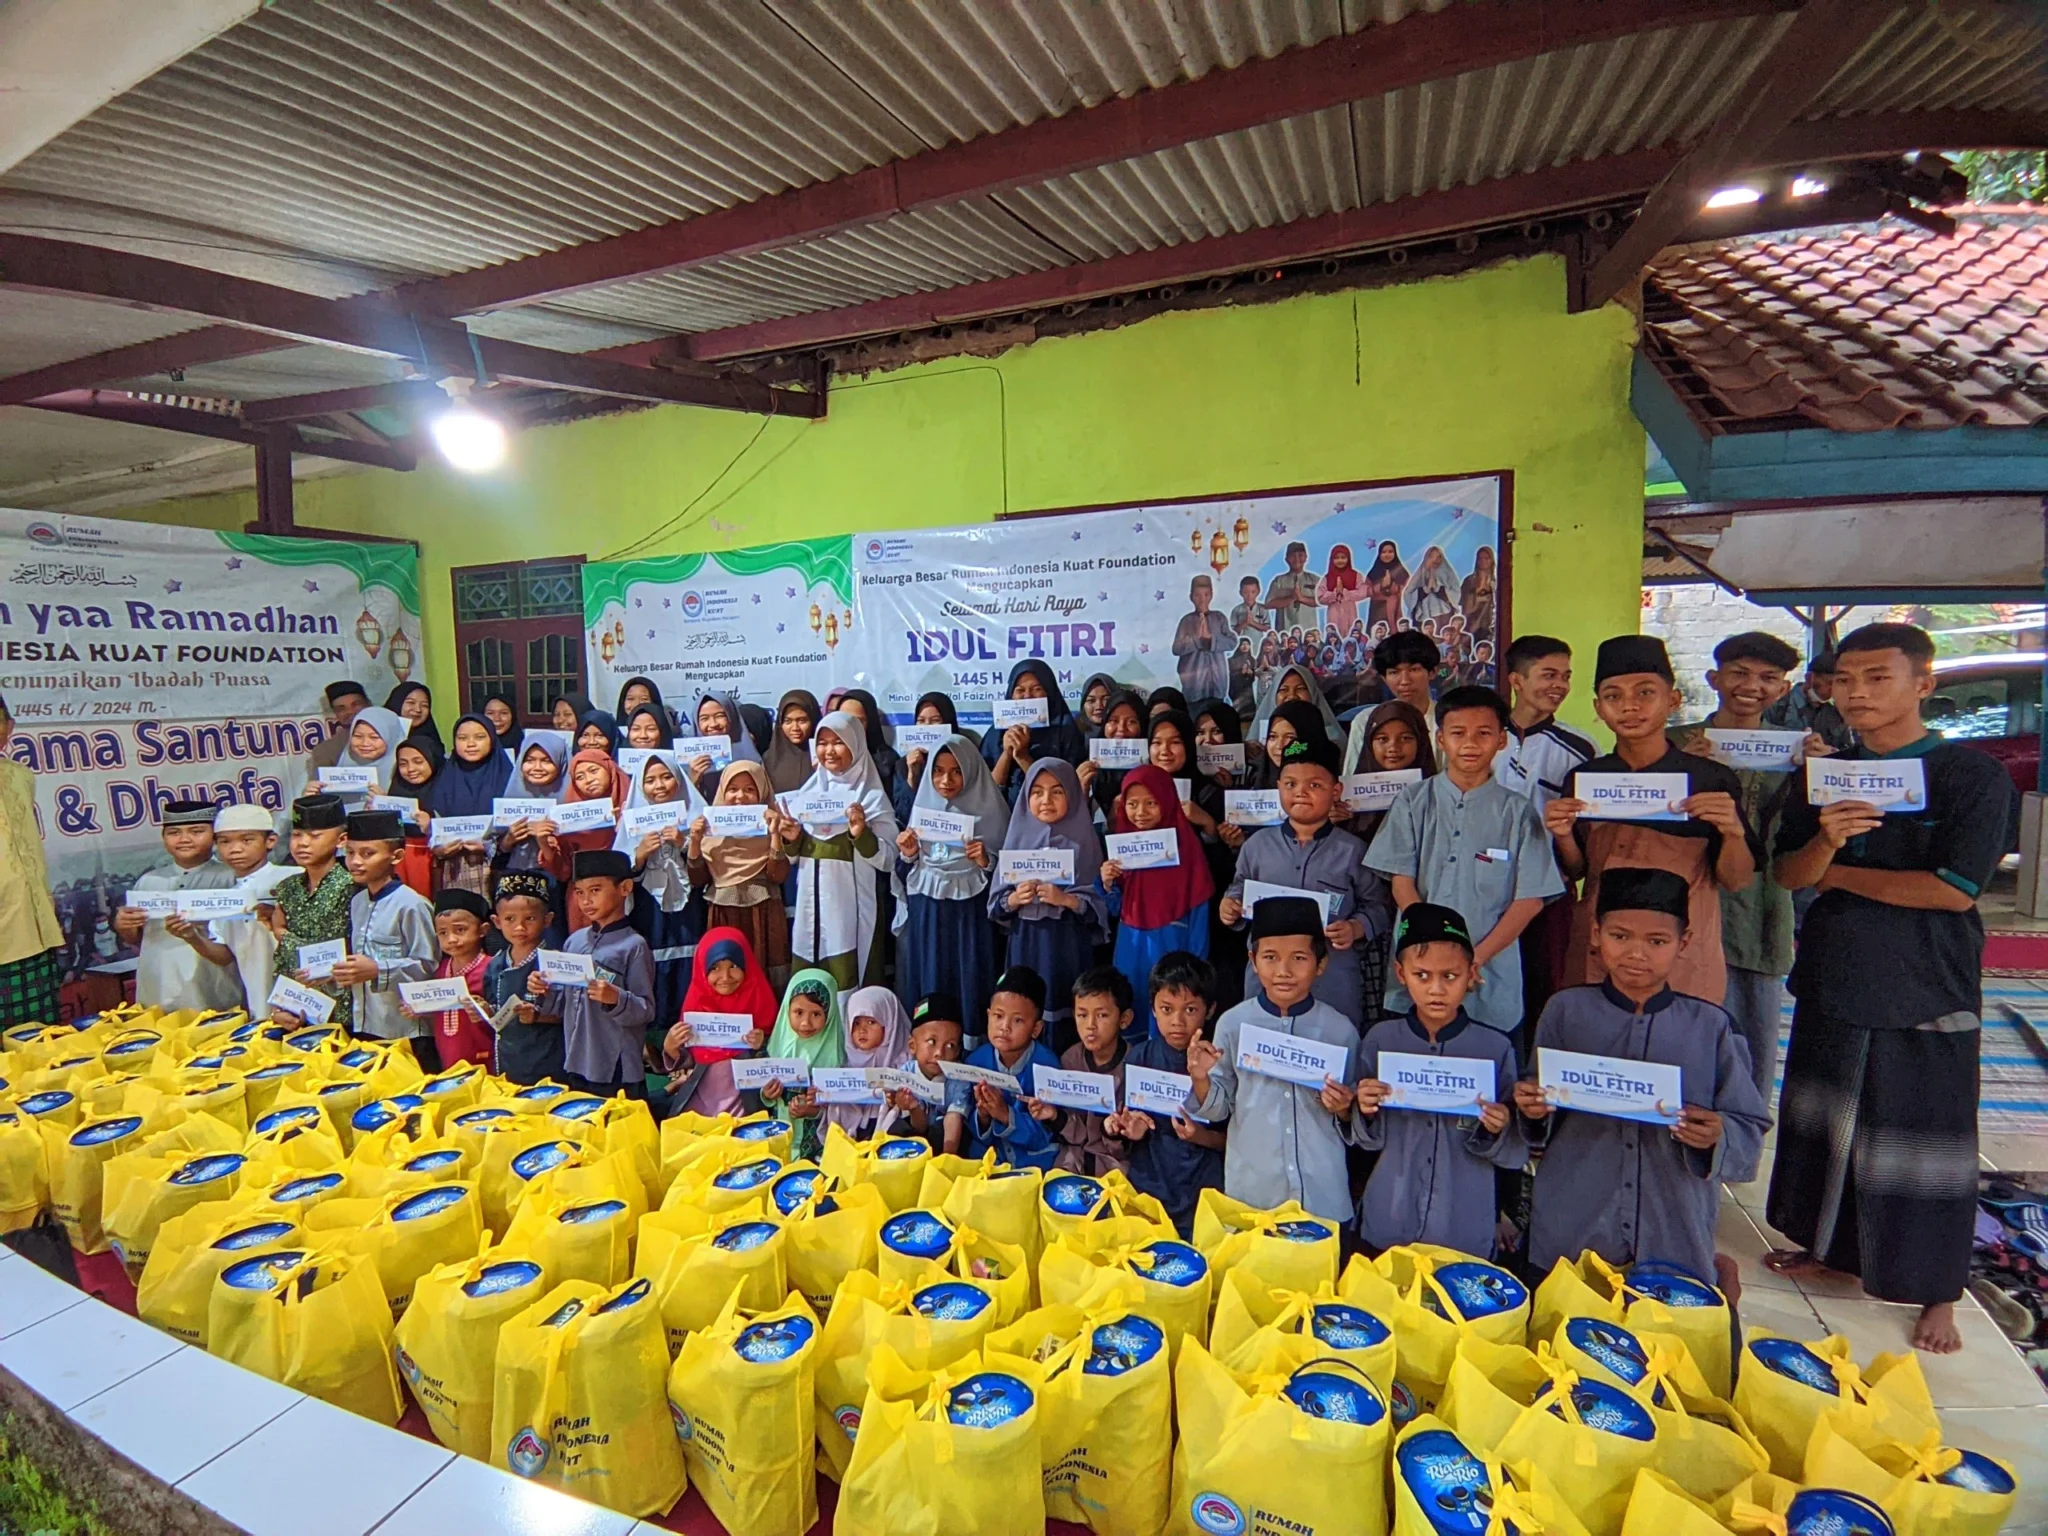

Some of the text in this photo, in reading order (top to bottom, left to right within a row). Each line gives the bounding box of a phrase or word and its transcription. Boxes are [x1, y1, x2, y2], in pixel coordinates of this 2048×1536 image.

[862, 573, 912, 586] Keluarga
[915, 571, 948, 583] Besar
[1063, 558, 1095, 572] Kuat
[1098, 552, 1176, 569] Foundation
[966, 577, 1054, 594] Mengucapkan
[940, 594, 1087, 618] Selamat Hari Raya
[27, 603, 113, 635] yaa
[125, 601, 338, 634] Ramadhan
[907, 621, 1117, 663] IDUL FITRI
[90, 643, 168, 662] KUAT
[177, 645, 344, 663] FOUNDATION
[614, 652, 827, 674] Keluarga Besar Rumah Indonesia Kuat Foundation
[0, 670, 271, 691] enunaikan Ibadah Puasa
[685, 670, 745, 682] Mengucapkan
[953, 670, 1072, 686] 1445 H M
[888, 693, 914, 702] Minal
[963, 690, 994, 700] Faizin
[14, 704, 52, 717] 1445
[92, 702, 131, 715] 2024
[1721, 743, 1791, 753] IDUL FITRI
[1824, 775, 1904, 788] IDUL FITRI
[1354, 786, 1378, 795] IDUL
[1593, 789, 1666, 799] IDUL FITRI
[57, 786, 99, 835] &
[824, 801, 844, 809] FITRI
[582, 809, 603, 818] FITRI
[636, 811, 676, 824] IDUL FITRI
[920, 818, 962, 832] IDUL FITRI
[1117, 842, 1164, 854] IDUL FITRI
[1012, 861, 1061, 869] IDUL FITRI
[546, 961, 583, 972] IDUL FITRI
[284, 988, 322, 1011] IDUL FITRI
[411, 988, 455, 1000] IDUL FITRI
[697, 1024, 741, 1033] IDUL FITRI
[1256, 1043, 1287, 1060] IDUL
[1290, 1051, 1326, 1069] FITRI
[746, 1066, 795, 1076] IDUL FITRI
[825, 1080, 846, 1088] IDUL
[1047, 1079, 1100, 1095] IDUL FITRI
[1140, 1081, 1164, 1092] IDUL
[1398, 1072, 1476, 1089] IDUL FITRI
[1561, 1070, 1603, 1088] IDUL
[1607, 1077, 1655, 1096] FITRI
[422, 1387, 444, 1405] KUAT
[1426, 1462, 1479, 1482] Ria Rio
[1254, 1509, 1315, 1536] RUMAH
